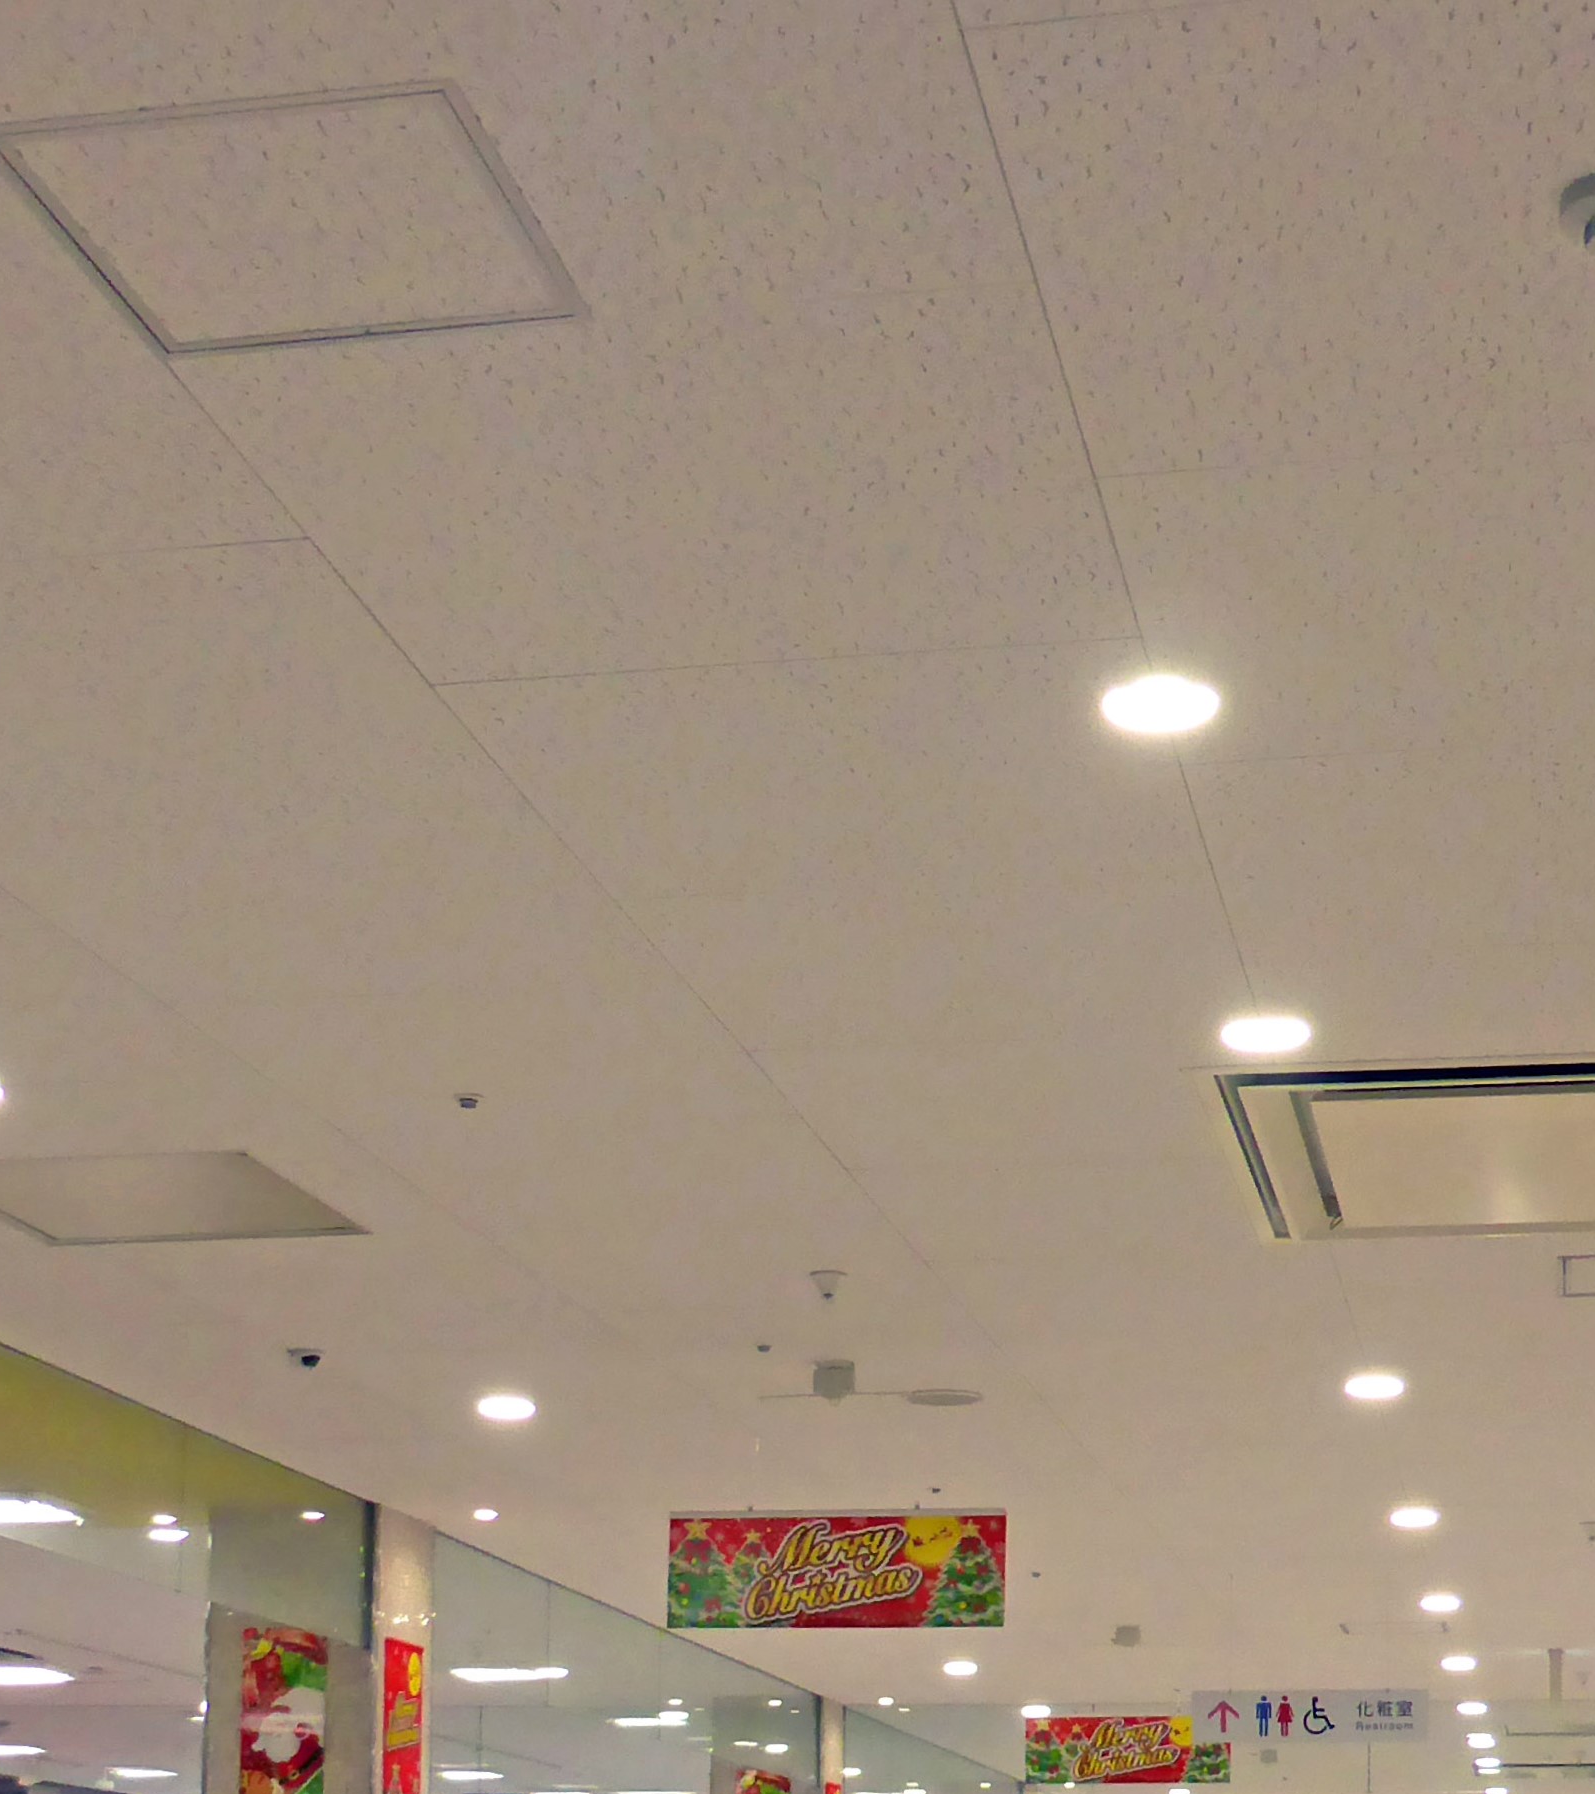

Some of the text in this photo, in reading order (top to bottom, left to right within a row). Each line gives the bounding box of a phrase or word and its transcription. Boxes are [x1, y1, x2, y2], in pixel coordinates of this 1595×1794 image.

[757, 1521, 905, 1572] Merry
[746, 1566, 921, 1620] Christmas
[1356, 1700, 1413, 1718] 化粧室
[1079, 1720, 1170, 1751] Merry
[1356, 1721, 1414, 1731] Restroom
[1074, 1746, 1179, 1780] Christmas
